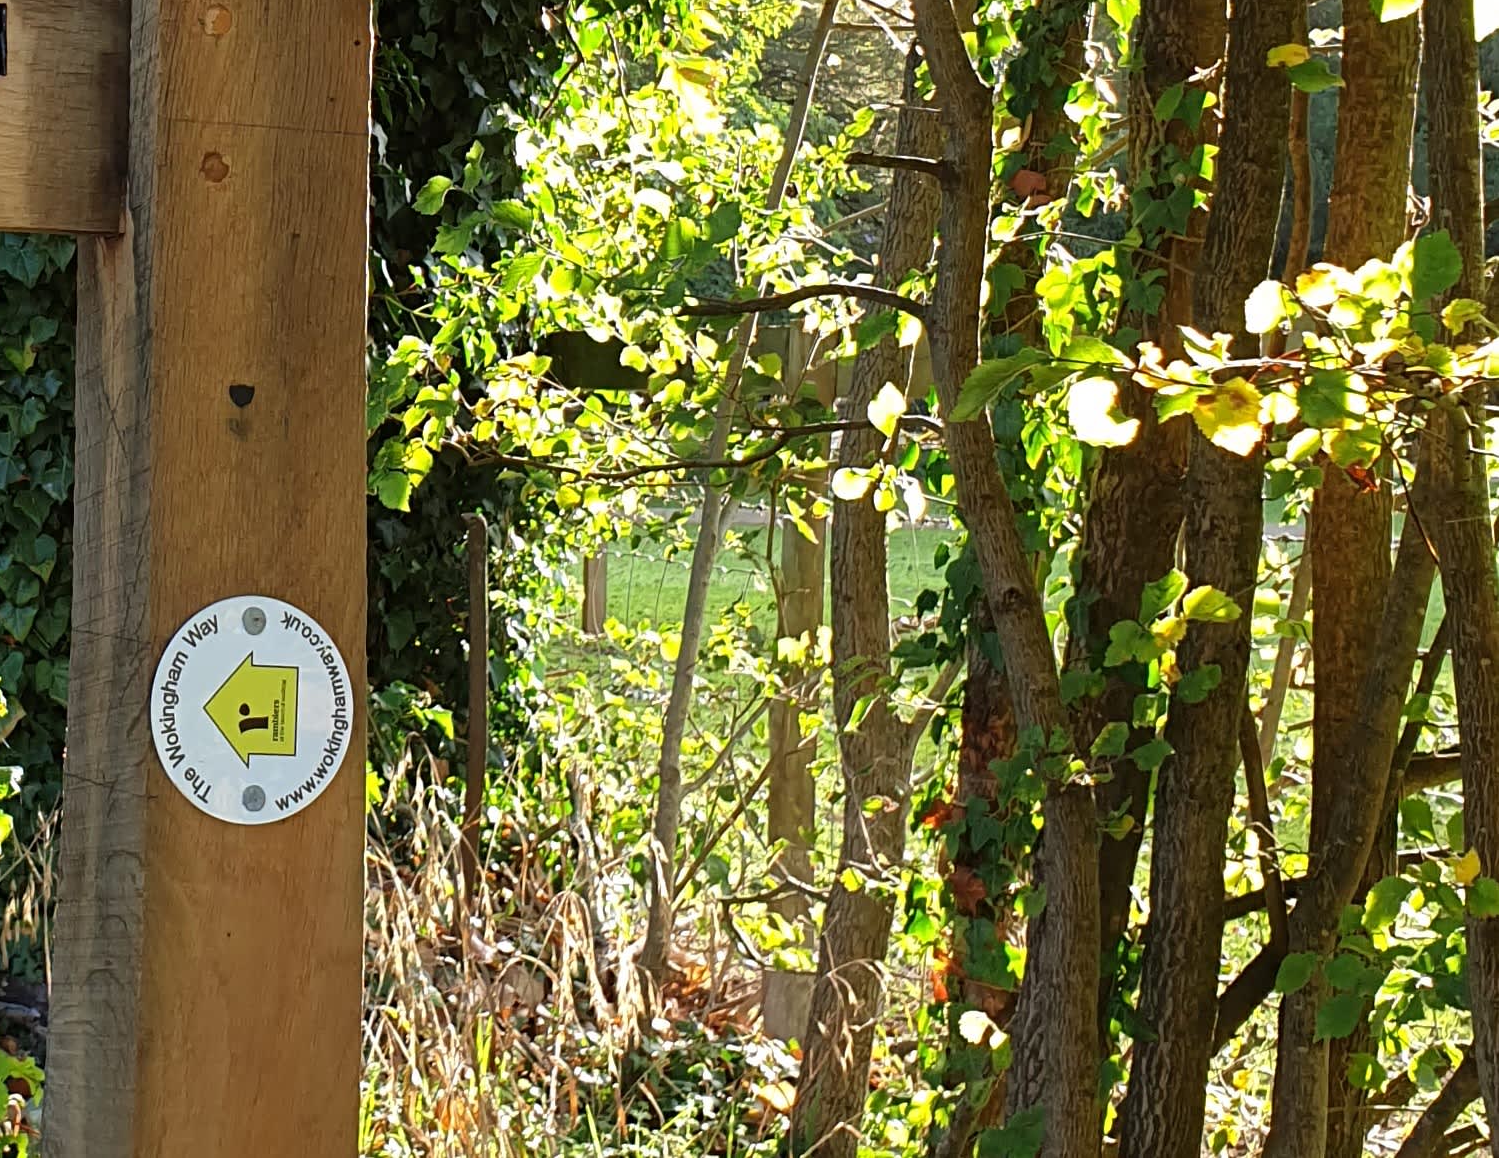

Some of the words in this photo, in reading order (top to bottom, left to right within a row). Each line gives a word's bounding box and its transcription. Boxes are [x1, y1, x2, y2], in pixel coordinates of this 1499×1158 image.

[181, 613, 219, 648] Way
[158, 650, 189, 769] Wokingham
[272, 699, 280, 742] ramblers
[274, 611, 350, 812] www.wokinghamway.co.uk
[183, 766, 213, 804] The
